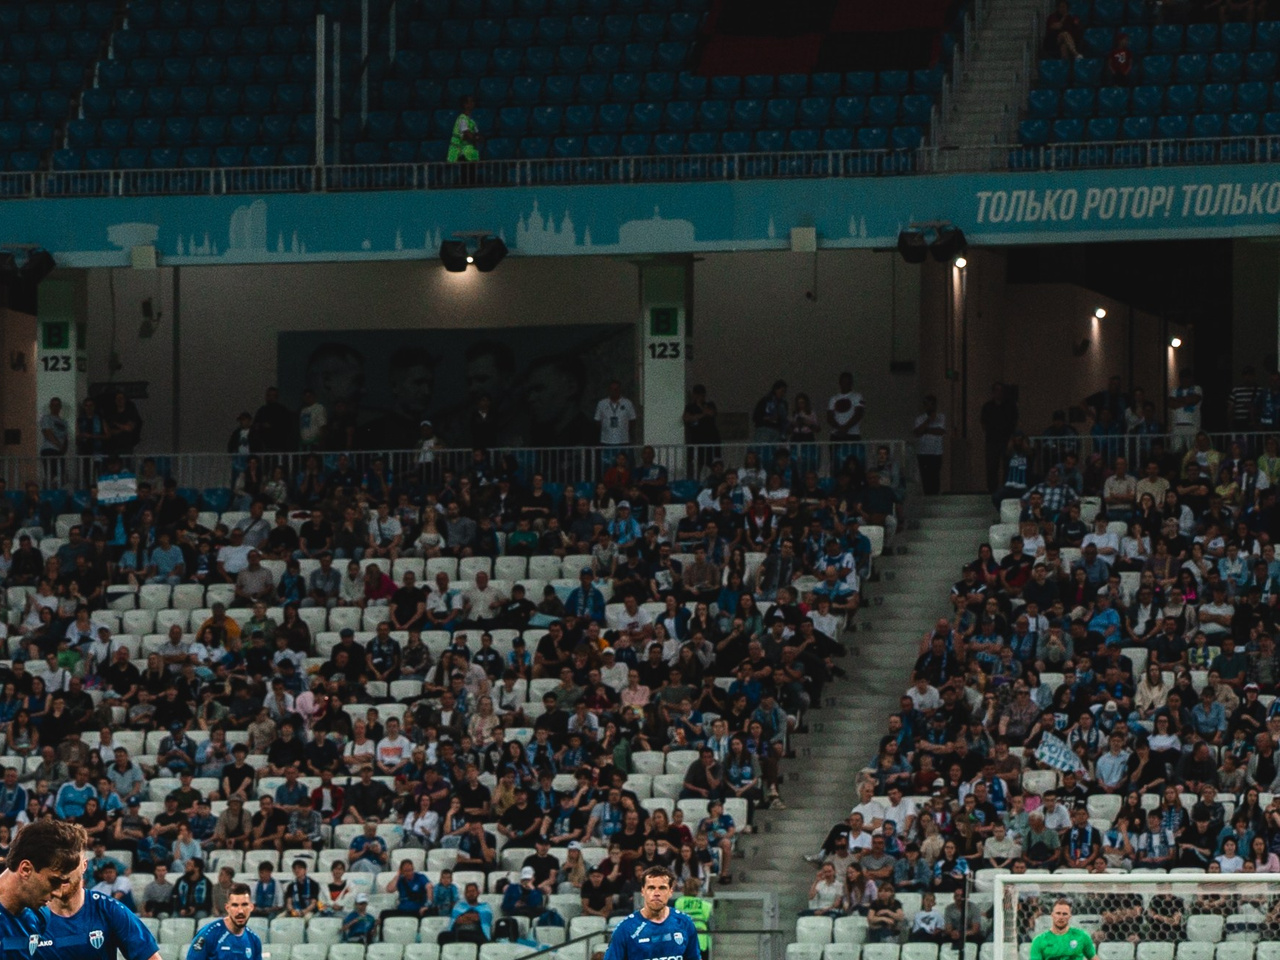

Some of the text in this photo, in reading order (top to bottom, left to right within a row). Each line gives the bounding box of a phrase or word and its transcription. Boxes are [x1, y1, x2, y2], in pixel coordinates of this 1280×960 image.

[976, 183, 1280, 223] ТОЛЬКО РОТОР! ТОЛЬКО
[648, 342, 680, 358] 123
[41, 355, 71, 371] 123
